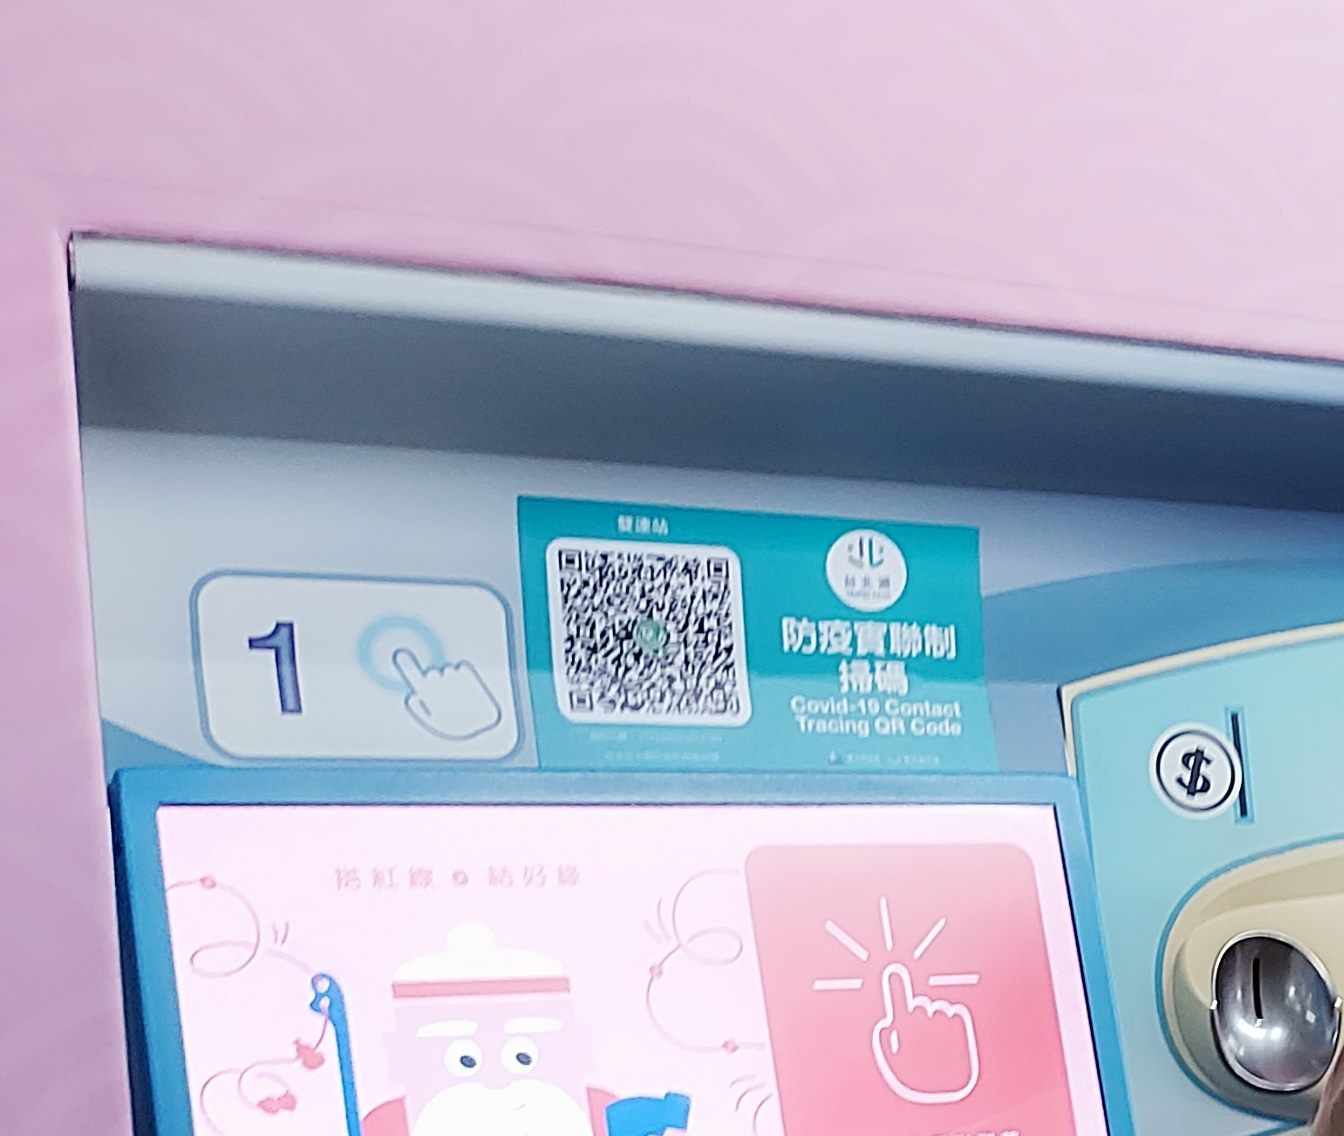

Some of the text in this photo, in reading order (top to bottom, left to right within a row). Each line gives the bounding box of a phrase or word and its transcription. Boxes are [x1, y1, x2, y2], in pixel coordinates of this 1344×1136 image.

[781, 616, 957, 661] 防疫實聯制
[248, 620, 303, 715] 1
[838, 657, 909, 696] 掃碼
[790, 695, 961, 719] Covid-19 Contact
[796, 714, 962, 738] Tracing QR Code
